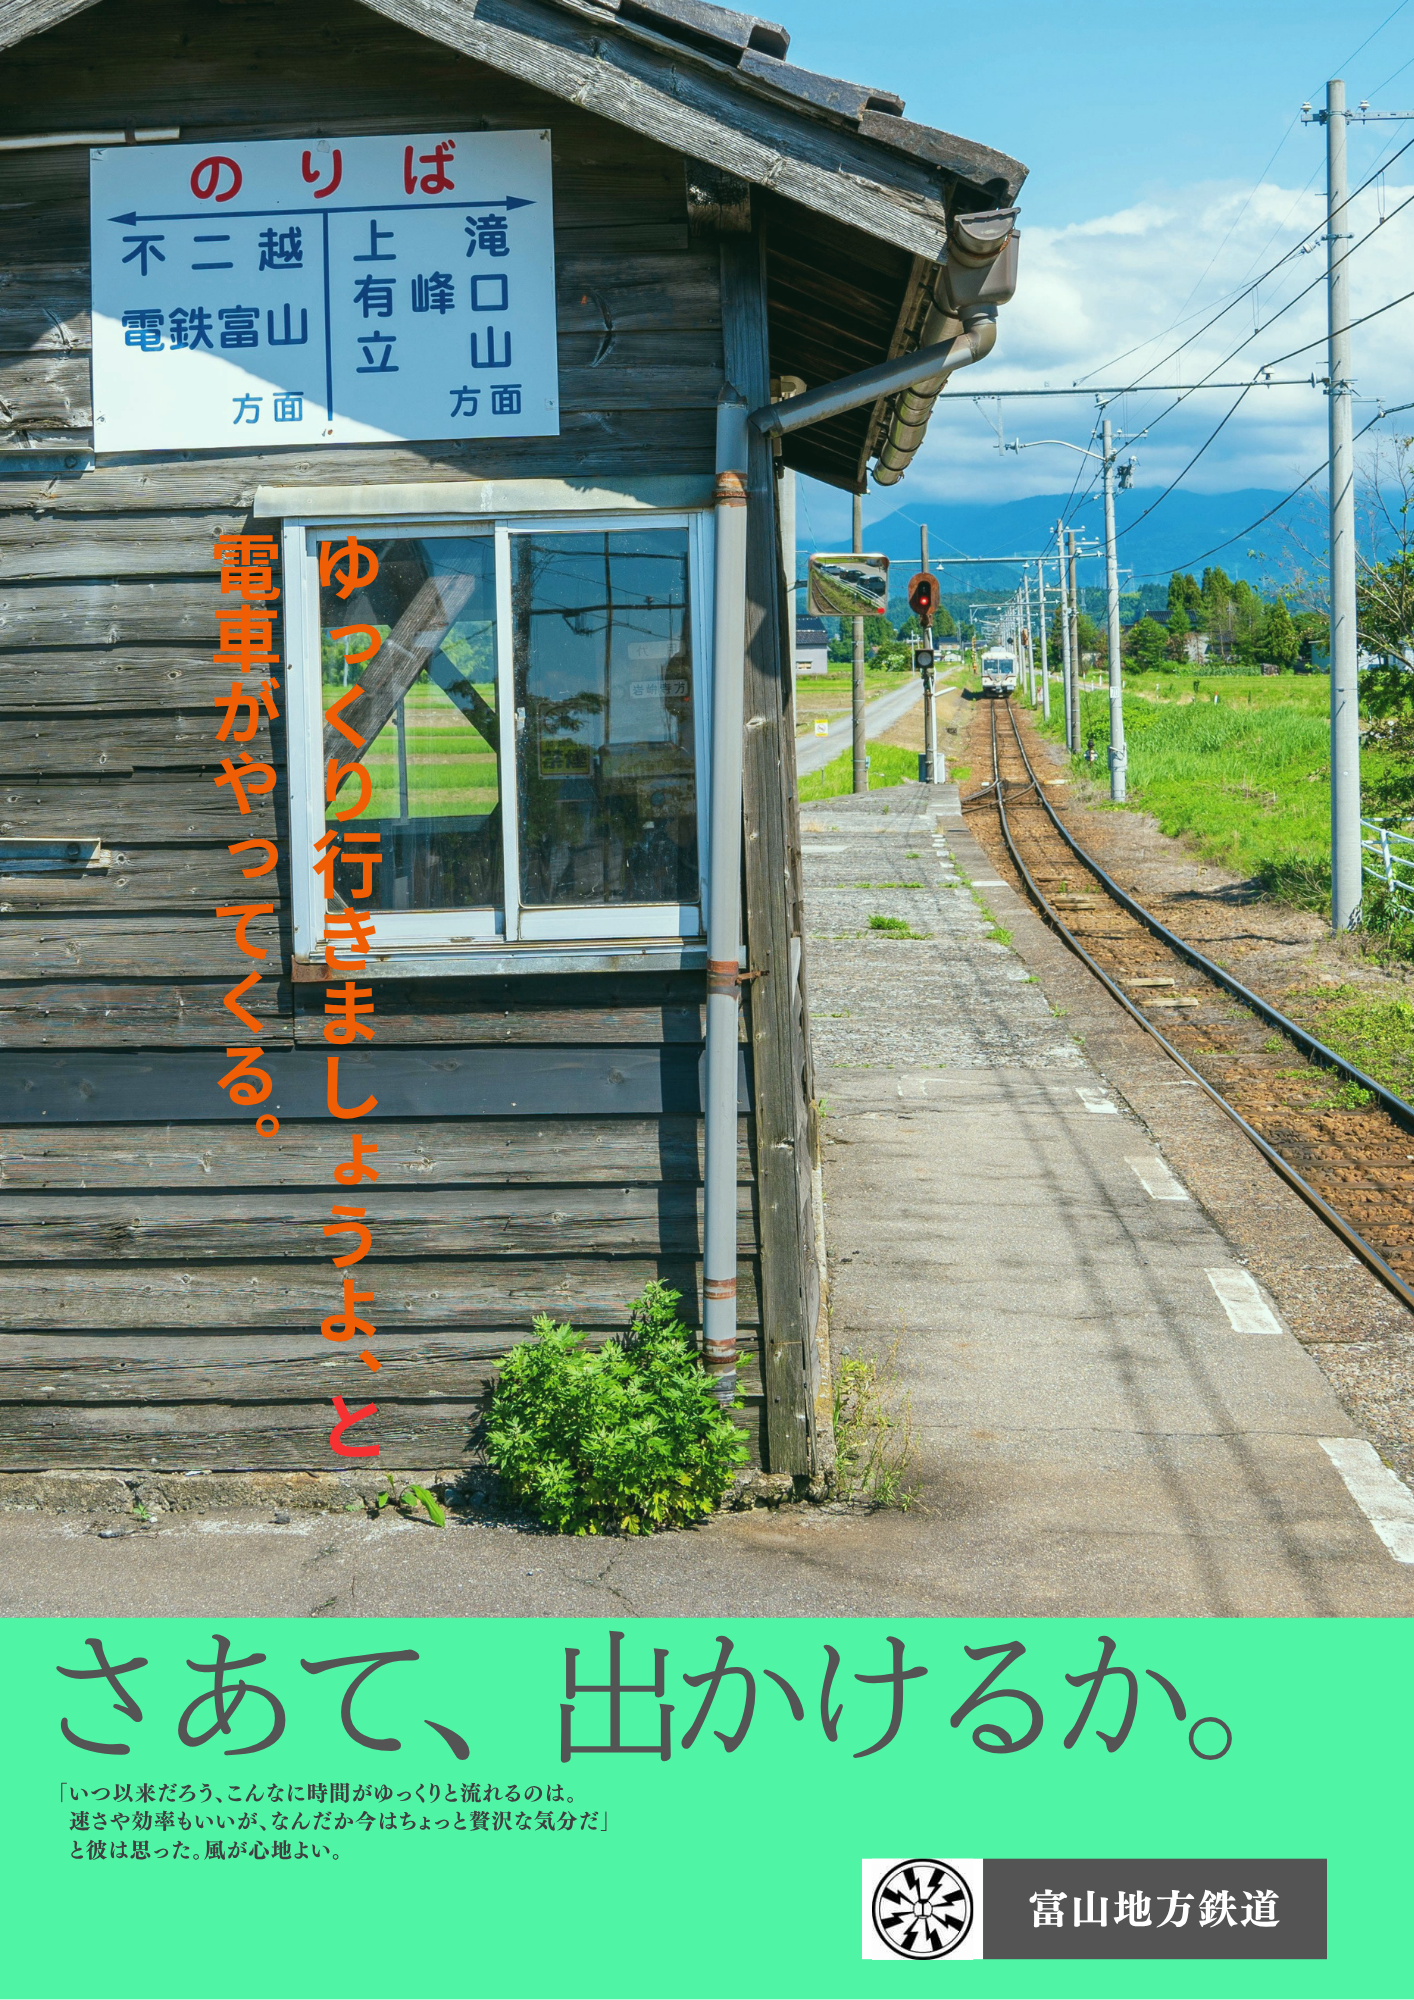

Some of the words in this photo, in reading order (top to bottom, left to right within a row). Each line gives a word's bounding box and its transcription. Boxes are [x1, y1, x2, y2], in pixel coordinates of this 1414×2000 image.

[191, 139, 457, 202] のりば
[122, 226, 303, 276] 不二越
[353, 271, 508, 319] 有峰口
[121, 303, 308, 352] 電鉄富山
[232, 391, 304, 425] 方面
[450, 384, 522, 418] 方面
